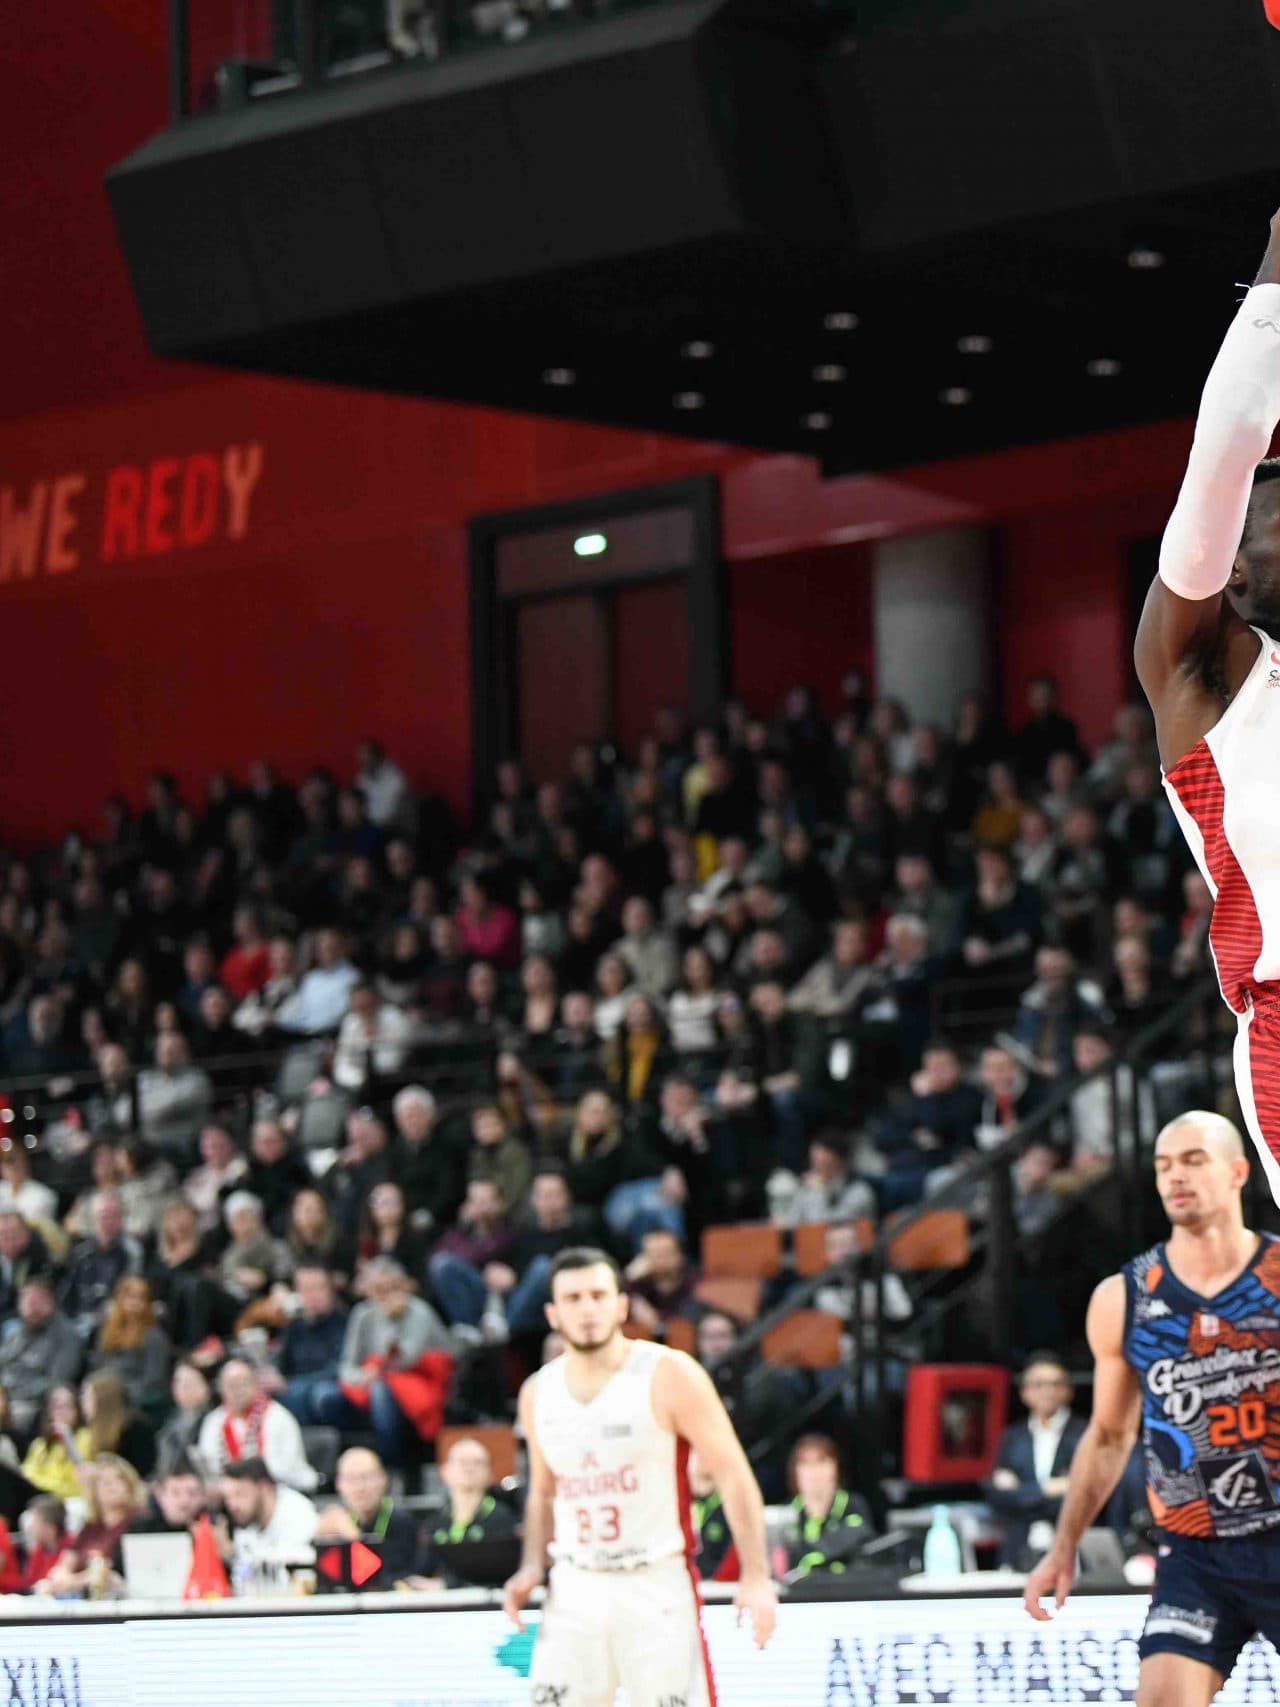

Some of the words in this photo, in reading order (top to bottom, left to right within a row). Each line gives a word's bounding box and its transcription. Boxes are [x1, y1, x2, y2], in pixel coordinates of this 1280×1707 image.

[0, 474, 86, 582] WE
[102, 438, 265, 564] REDY
[1206, 1401, 1267, 1447] 20
